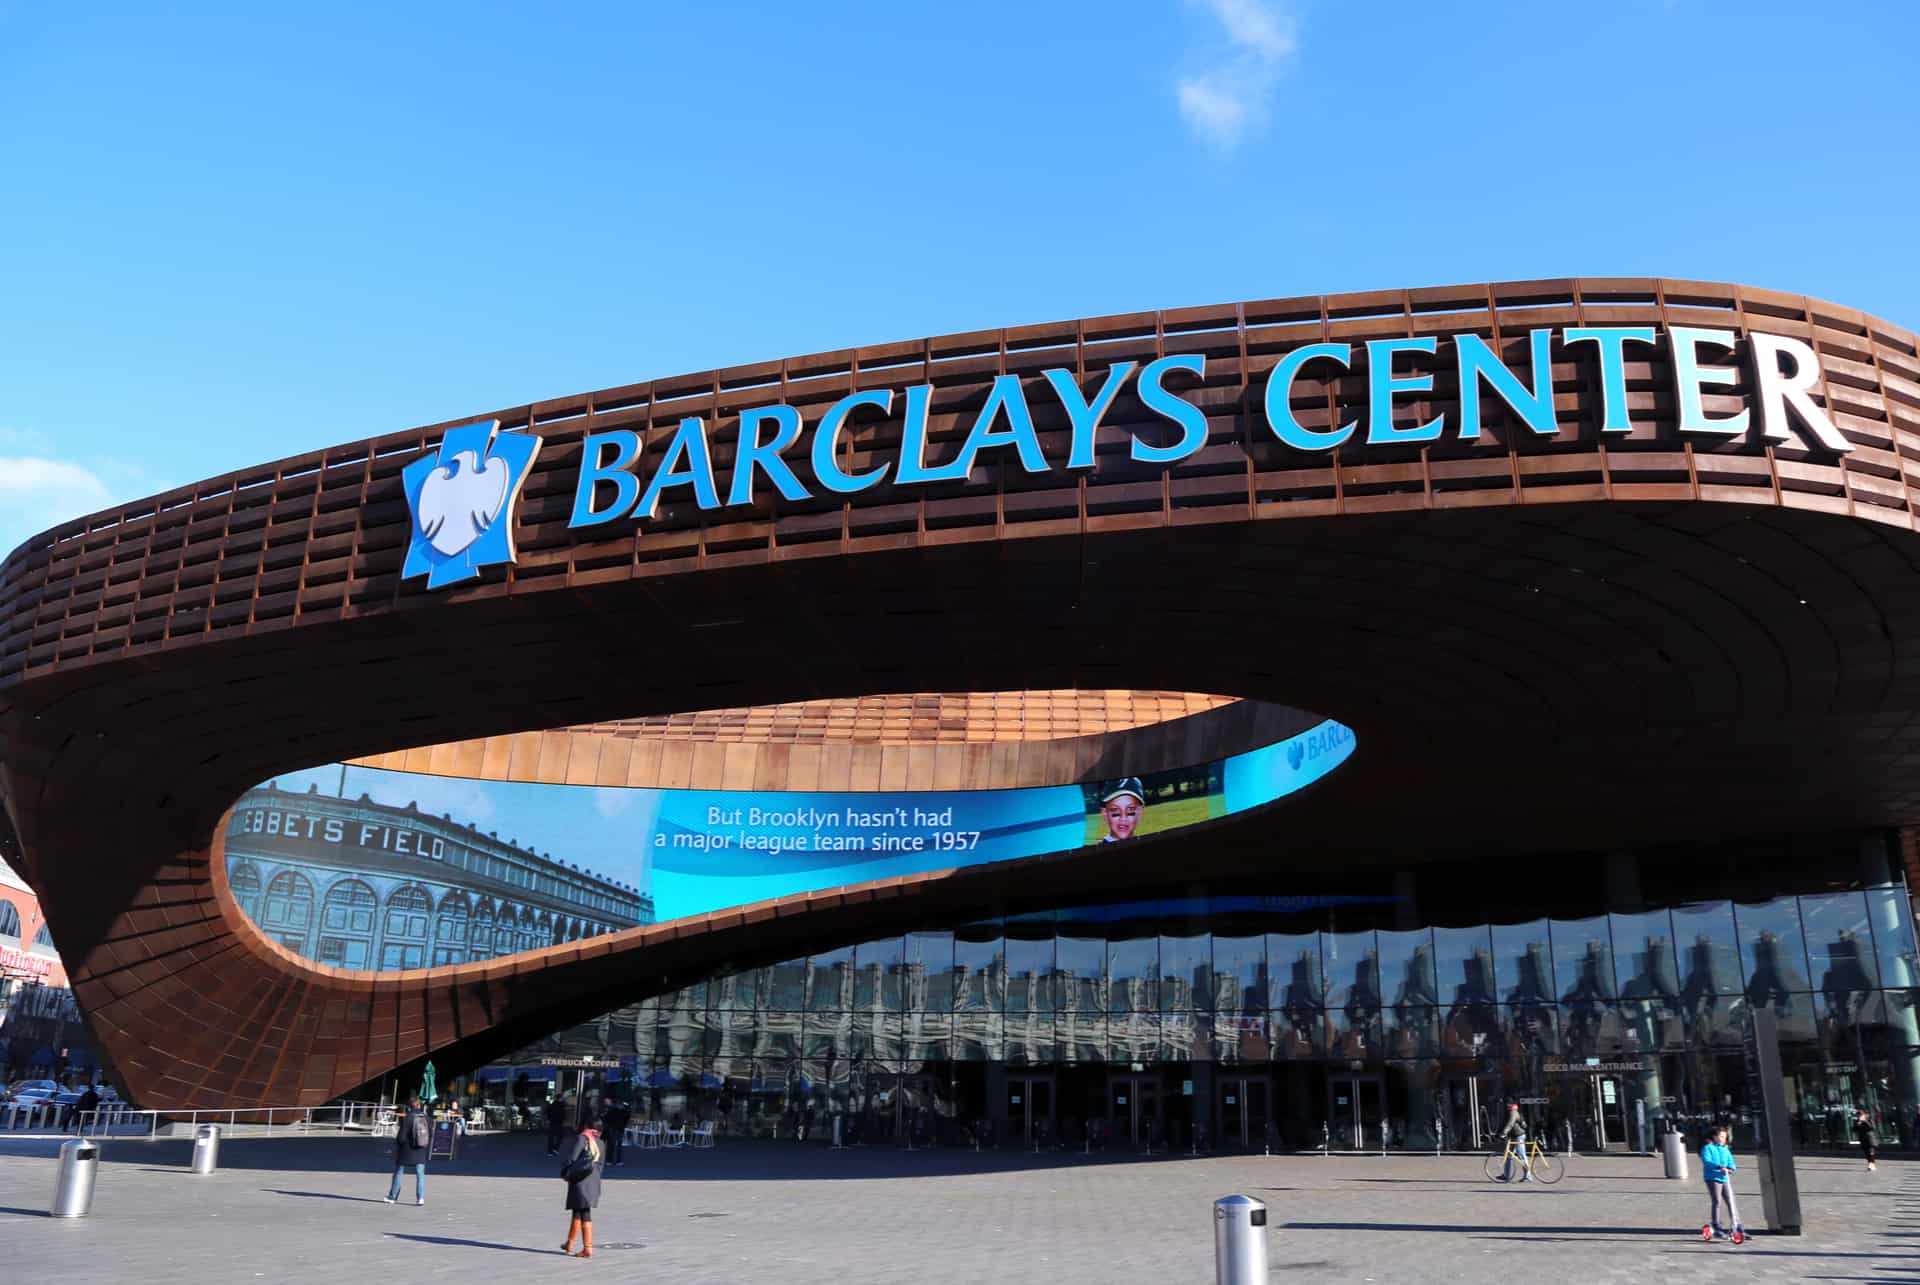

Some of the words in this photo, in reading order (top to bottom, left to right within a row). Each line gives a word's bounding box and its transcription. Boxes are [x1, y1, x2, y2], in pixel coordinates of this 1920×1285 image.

[568, 354, 1209, 528] BARCLAYS
[1265, 327, 1856, 451] CENTER
[243, 811, 344, 842] EBBETS
[359, 824, 445, 860] FIELD
[707, 807, 742, 826] But
[749, 806, 840, 831] Brooklyn
[846, 806, 907, 827] hasn't
[914, 806, 952, 827] had
[654, 833, 667, 847] a
[673, 831, 733, 852] major
[739, 831, 809, 855] league
[814, 832, 865, 851] team
[871, 831, 924, 851] since
[931, 831, 981, 851] 1957
